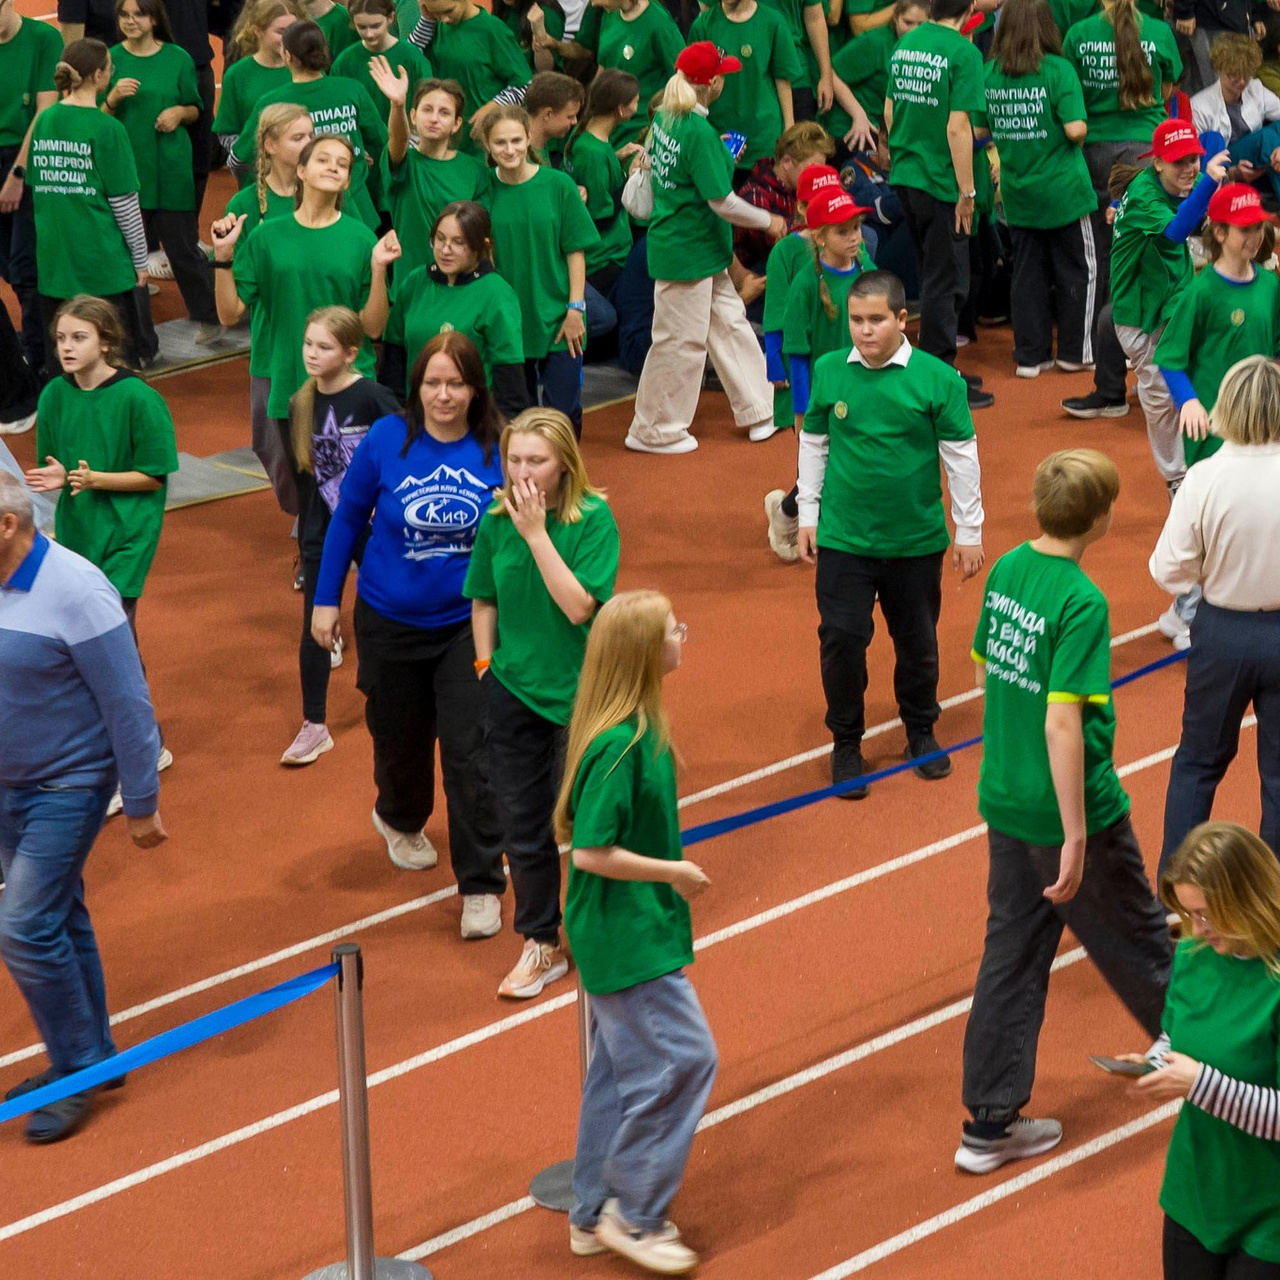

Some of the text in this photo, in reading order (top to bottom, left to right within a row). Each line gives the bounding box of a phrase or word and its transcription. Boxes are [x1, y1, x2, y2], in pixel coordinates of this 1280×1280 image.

[1082, 55, 1097, 67] ПО
[988, 100, 1044, 116] ПО ПЕРВОЙ
[314, 117, 357, 136] ЕРВОЙ
[33, 155, 48, 167] ПО
[440, 484, 457, 493] КЛУБ
